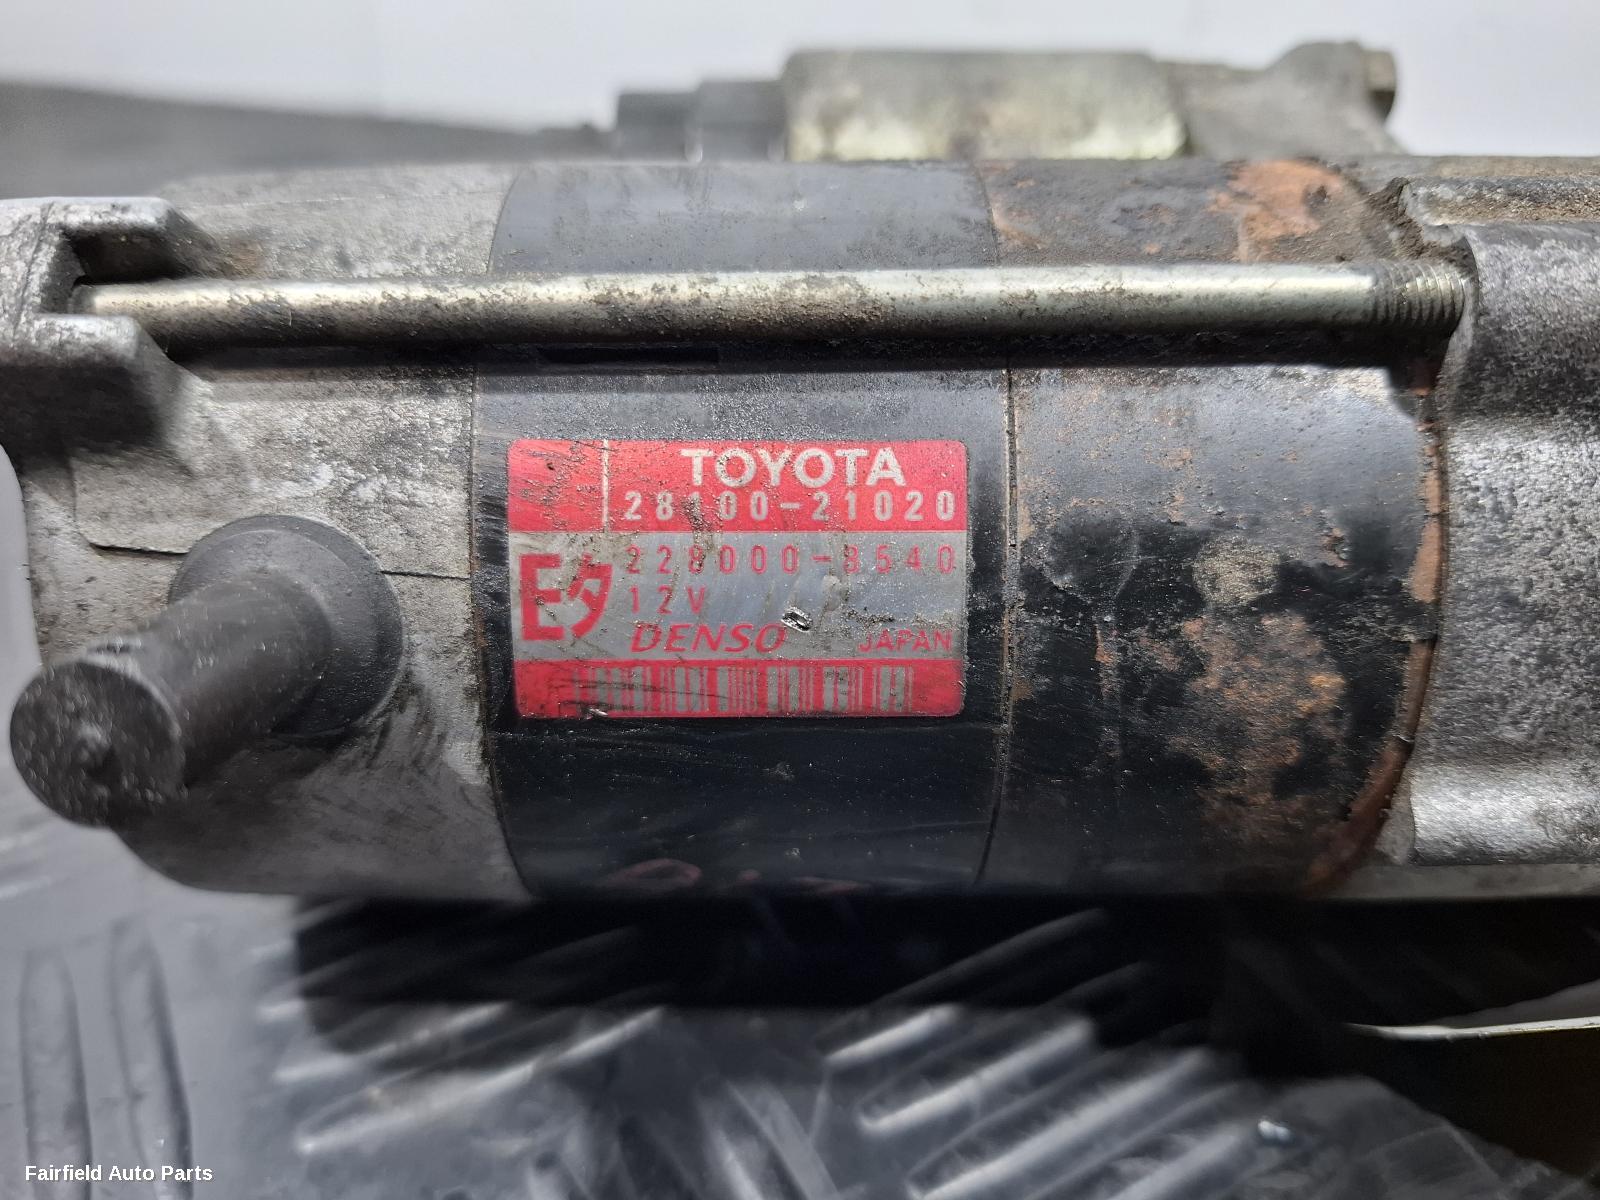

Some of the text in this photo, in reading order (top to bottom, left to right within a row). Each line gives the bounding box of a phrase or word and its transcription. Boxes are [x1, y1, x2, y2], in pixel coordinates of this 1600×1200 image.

[681, 448, 906, 487] TOYOTA
[624, 490, 956, 521] 28100-21020
[625, 543, 956, 575] 228000-8540
[630, 623, 787, 653] DENSO
[858, 628, 953, 652] JAPAN
